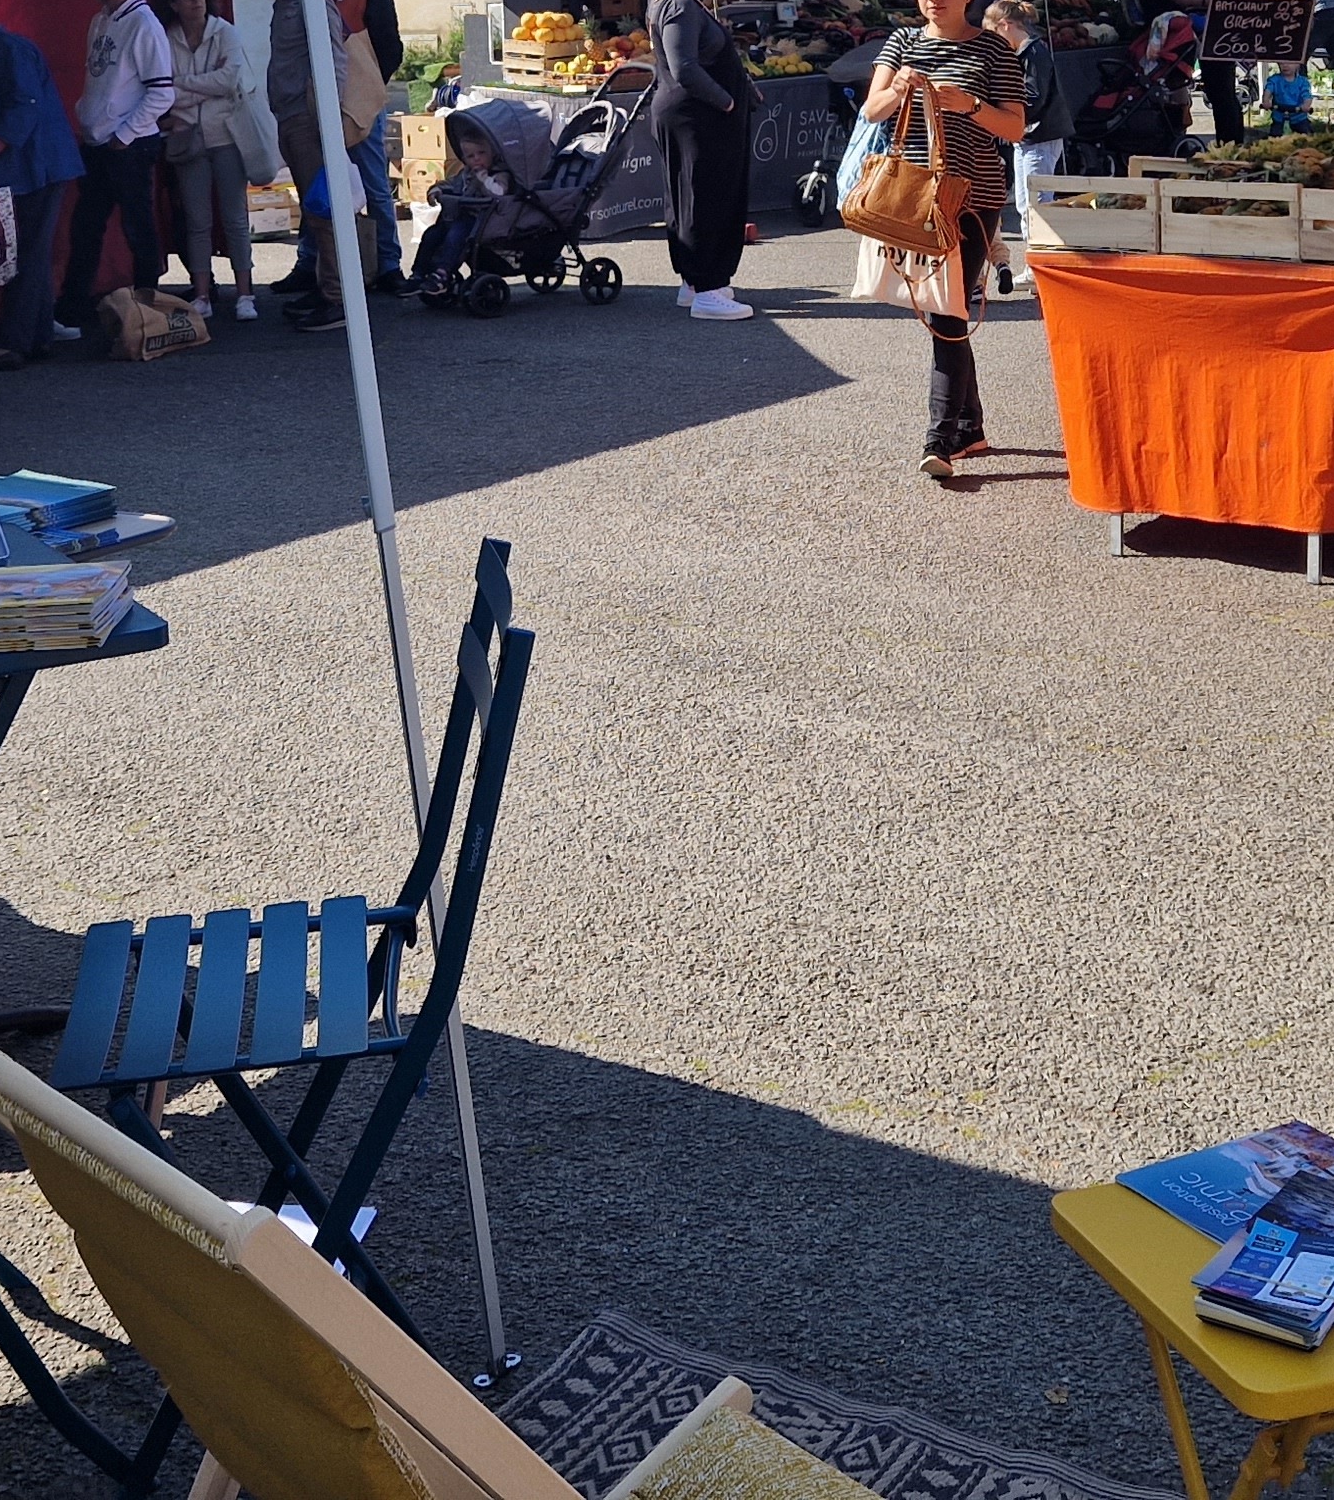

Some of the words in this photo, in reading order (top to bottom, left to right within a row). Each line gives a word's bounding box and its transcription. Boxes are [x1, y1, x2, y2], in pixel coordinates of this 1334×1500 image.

[1215, 1, 1273, 11] ARTICHAUT
[1224, 14, 1271, 29] BRETON
[1274, 36, 1293, 54] 3
[799, 109, 834, 126] SAVE
[149, 336, 162, 349] AU
[1161, 1178, 1239, 1227] Destination
